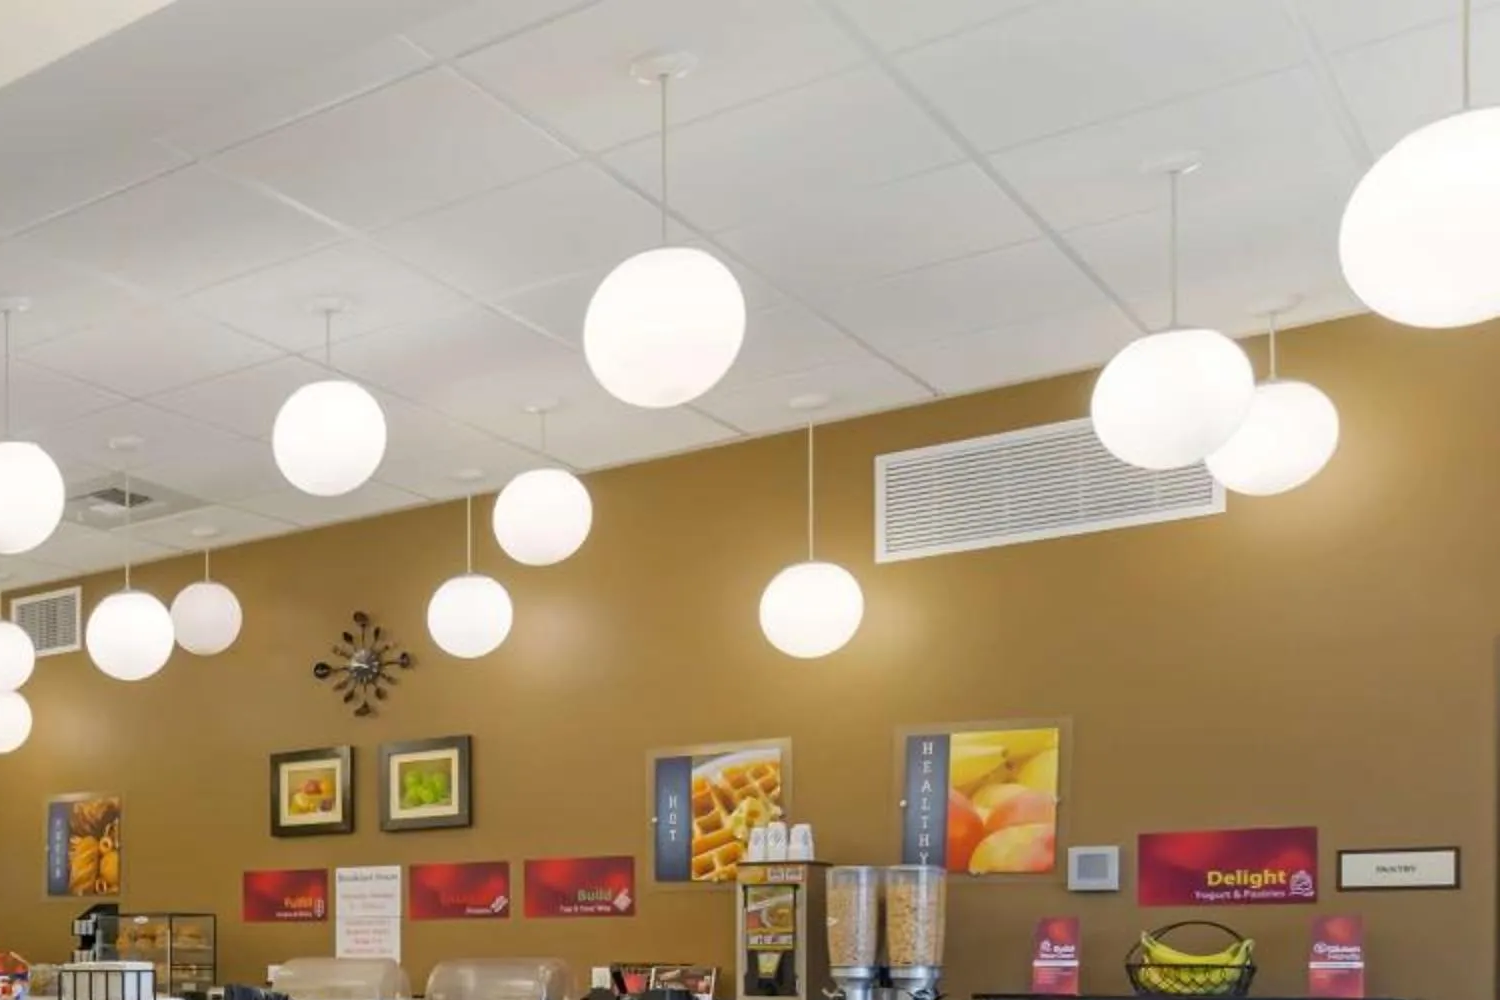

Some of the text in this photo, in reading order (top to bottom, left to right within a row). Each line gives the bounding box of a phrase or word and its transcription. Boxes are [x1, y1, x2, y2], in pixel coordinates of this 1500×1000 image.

[668, 795, 678, 841] HOT
[919, 742, 933, 864] HEALTHY
[578, 888, 612, 901] Build
[1207, 869, 1287, 889] Delight
